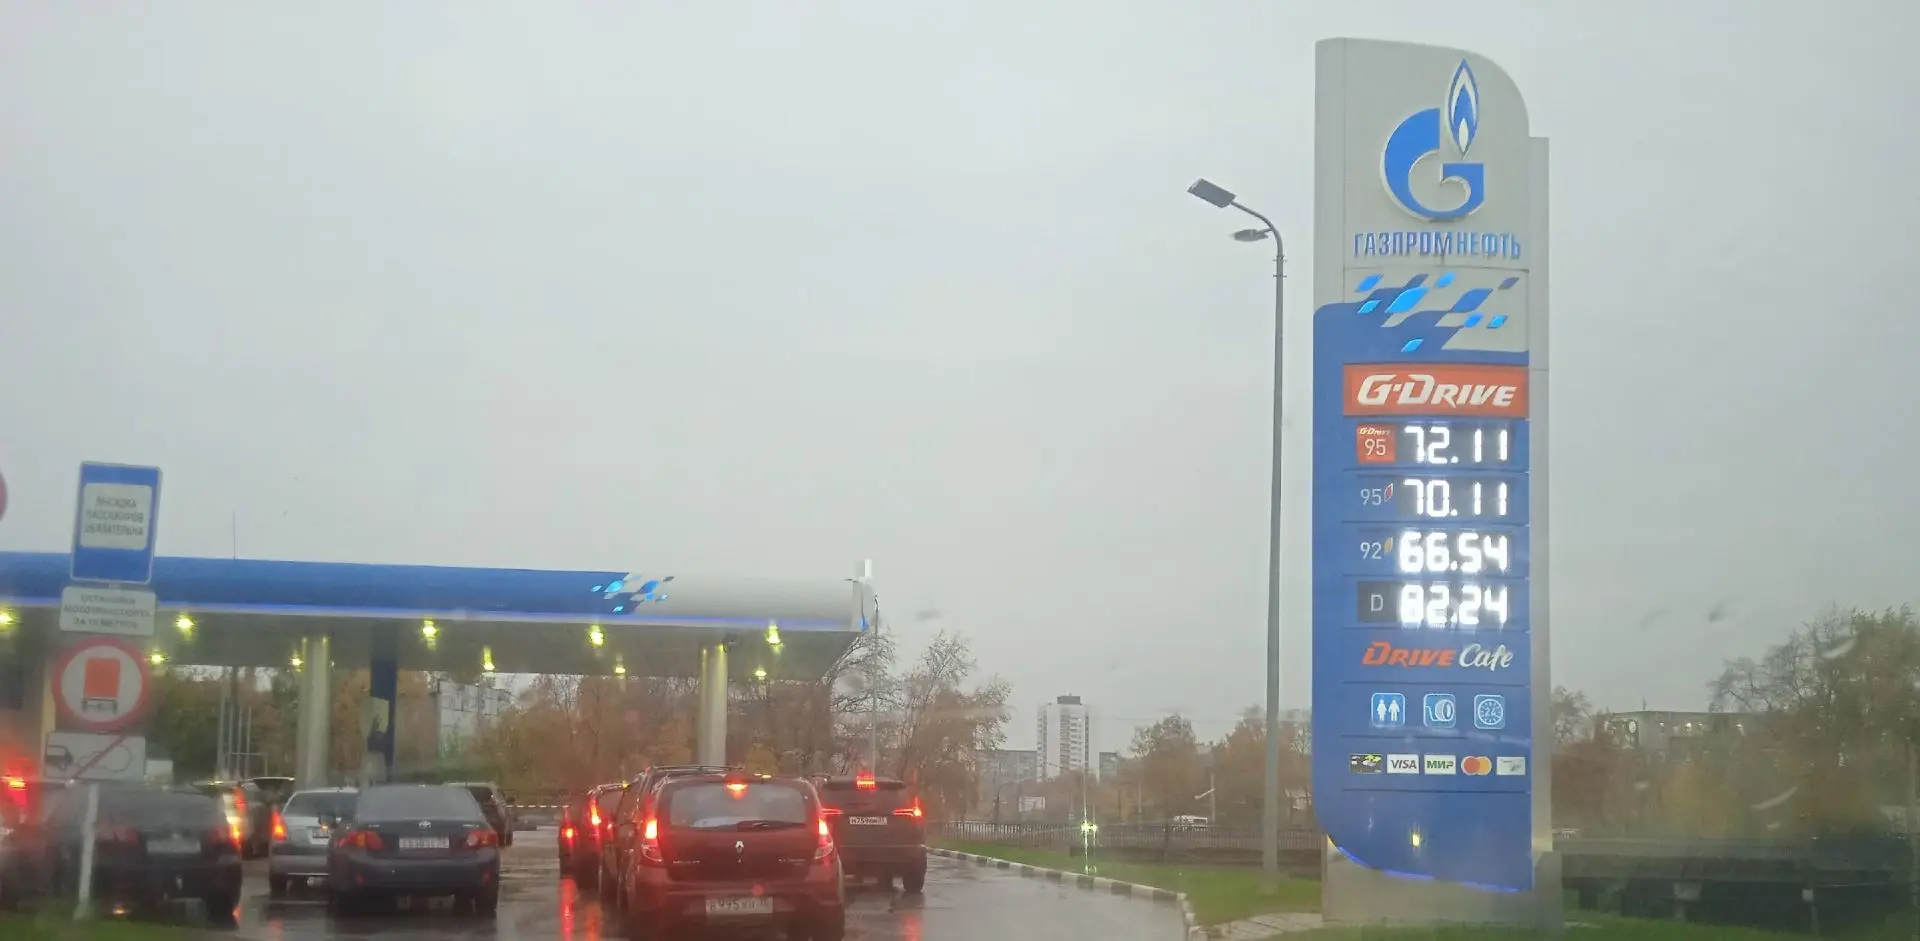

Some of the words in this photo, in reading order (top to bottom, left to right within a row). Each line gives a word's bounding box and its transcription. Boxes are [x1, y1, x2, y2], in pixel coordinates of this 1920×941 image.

[1353, 230, 1522, 260] ГАЗПРОМНЕФТЬ
[1364, 438, 1386, 456] 95
[1404, 425, 1508, 464] 72.11
[1360, 488, 1382, 505] 95
[1403, 478, 1508, 517] 70.11
[1360, 542, 1382, 560] 92
[1400, 531, 1508, 573] 66.54
[1370, 594, 1384, 612] D
[1400, 584, 1508, 625] 82.24
[1362, 640, 1457, 668] DRIVE
[1459, 643, 1513, 671] Cafe
[1391, 759, 1417, 769] VISA
[1427, 760, 1454, 769] МИР
